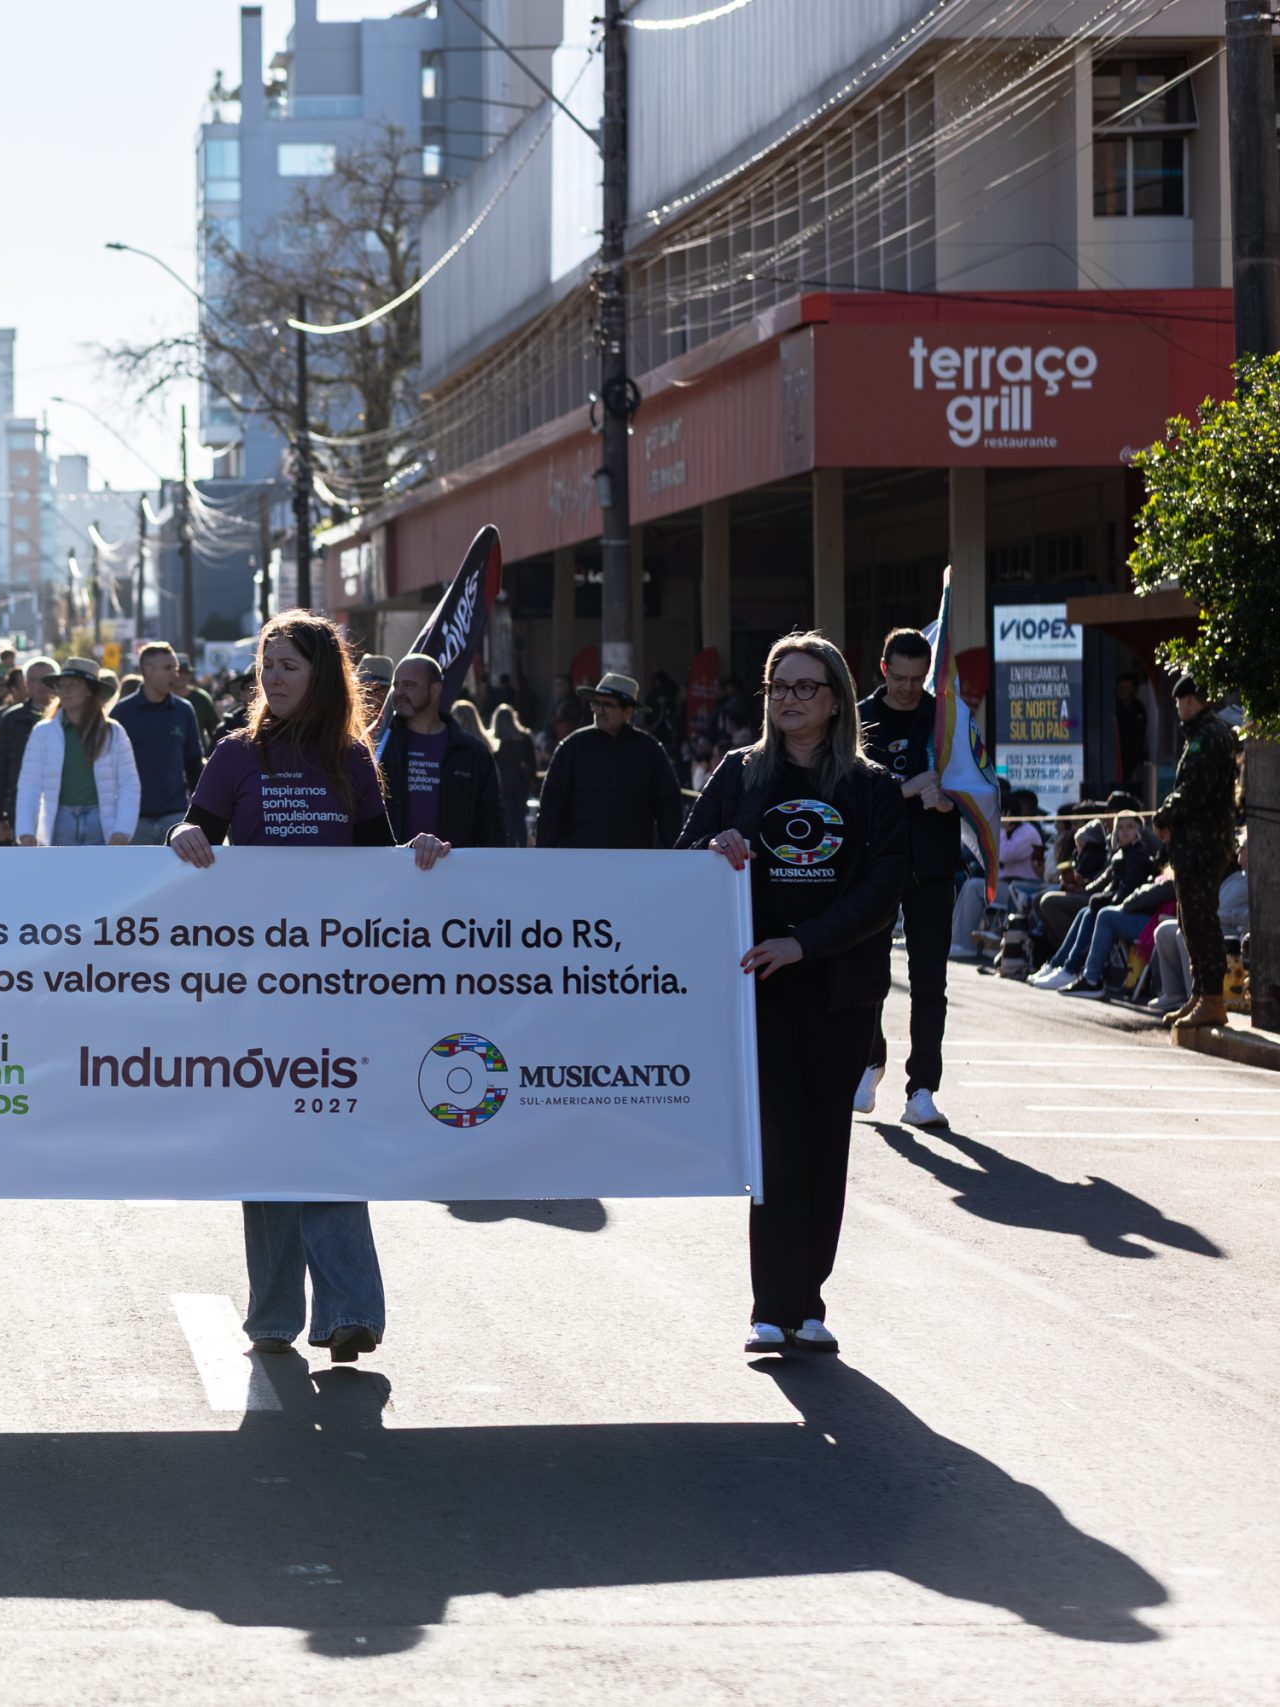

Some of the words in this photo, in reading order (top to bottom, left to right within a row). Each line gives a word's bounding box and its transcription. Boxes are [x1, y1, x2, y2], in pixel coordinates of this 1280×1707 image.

[909, 336, 1098, 396] terraço
[946, 385, 1032, 448] grill
[984, 436, 1057, 449] restaurante
[1000, 617, 1076, 641] VIOPEX
[1010, 665, 1060, 682] ENTREGAMOS
[1061, 665, 1068, 680] A
[1008, 683, 1024, 700] SUA
[1010, 700, 1023, 719] DE
[1025, 700, 1058, 719] NORTE
[1060, 699, 1069, 719] A
[1010, 721, 1028, 740] SUL
[1031, 721, 1045, 739] DO
[262, 784, 327, 797] Inspiramos
[262, 797, 310, 809] sonhos,
[263, 810, 349, 824] impulsionamos
[265, 822, 319, 837] negócios
[769, 868, 835, 877] MUSICANTO
[19, 924, 82, 946] aos
[93, 917, 160, 947] 185
[170, 924, 255, 948] anos
[265, 918, 310, 948] da
[320, 917, 432, 949] Polícia
[441, 918, 512, 949] Civil
[521, 919, 563, 949] do
[573, 918, 622, 953] RS,
[43, 963, 170, 994] valores
[180, 972, 247, 1003] que
[257, 968, 446, 995] constroem
[455, 973, 554, 995] nossa
[562, 963, 688, 995] história.
[519, 1063, 691, 1088] MUSICANTO
[294, 1098, 358, 1114] 2027
[519, 1096, 611, 1106] SUL-AMERICANO
[614, 1096, 628, 1105] DE
[630, 1095, 691, 1104] NATIVISMO
